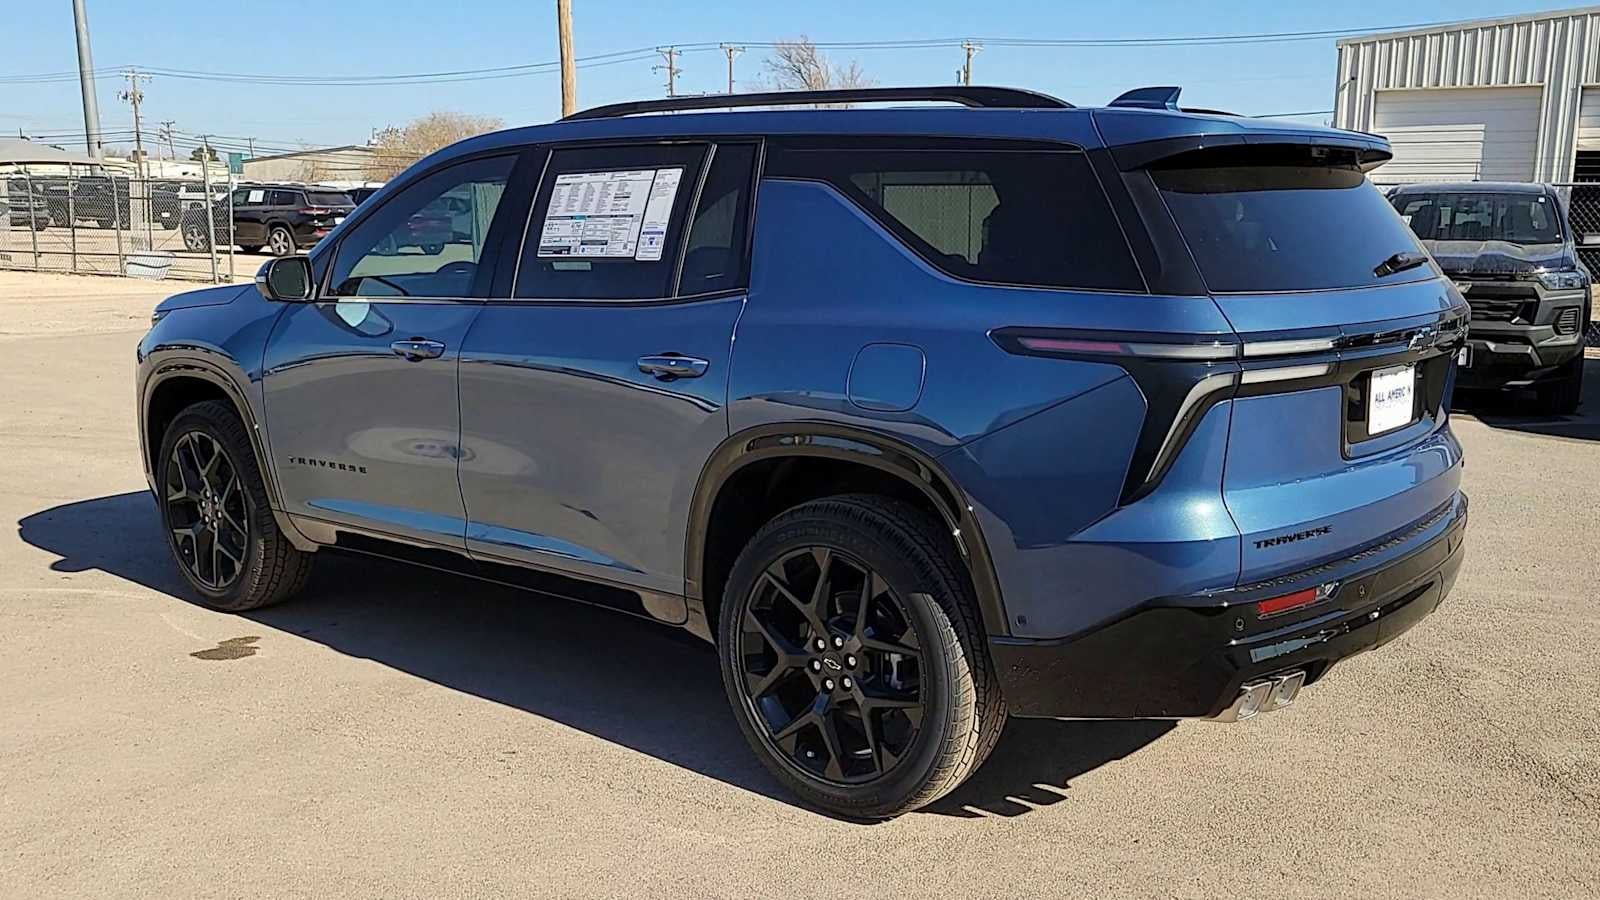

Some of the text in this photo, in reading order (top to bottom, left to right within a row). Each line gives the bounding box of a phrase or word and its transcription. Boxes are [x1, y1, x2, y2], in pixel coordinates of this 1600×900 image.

[1375, 391, 1385, 402] ALL
[288, 455, 367, 474] TRAVERSE
[1253, 525, 1332, 549] TRAVERSE
